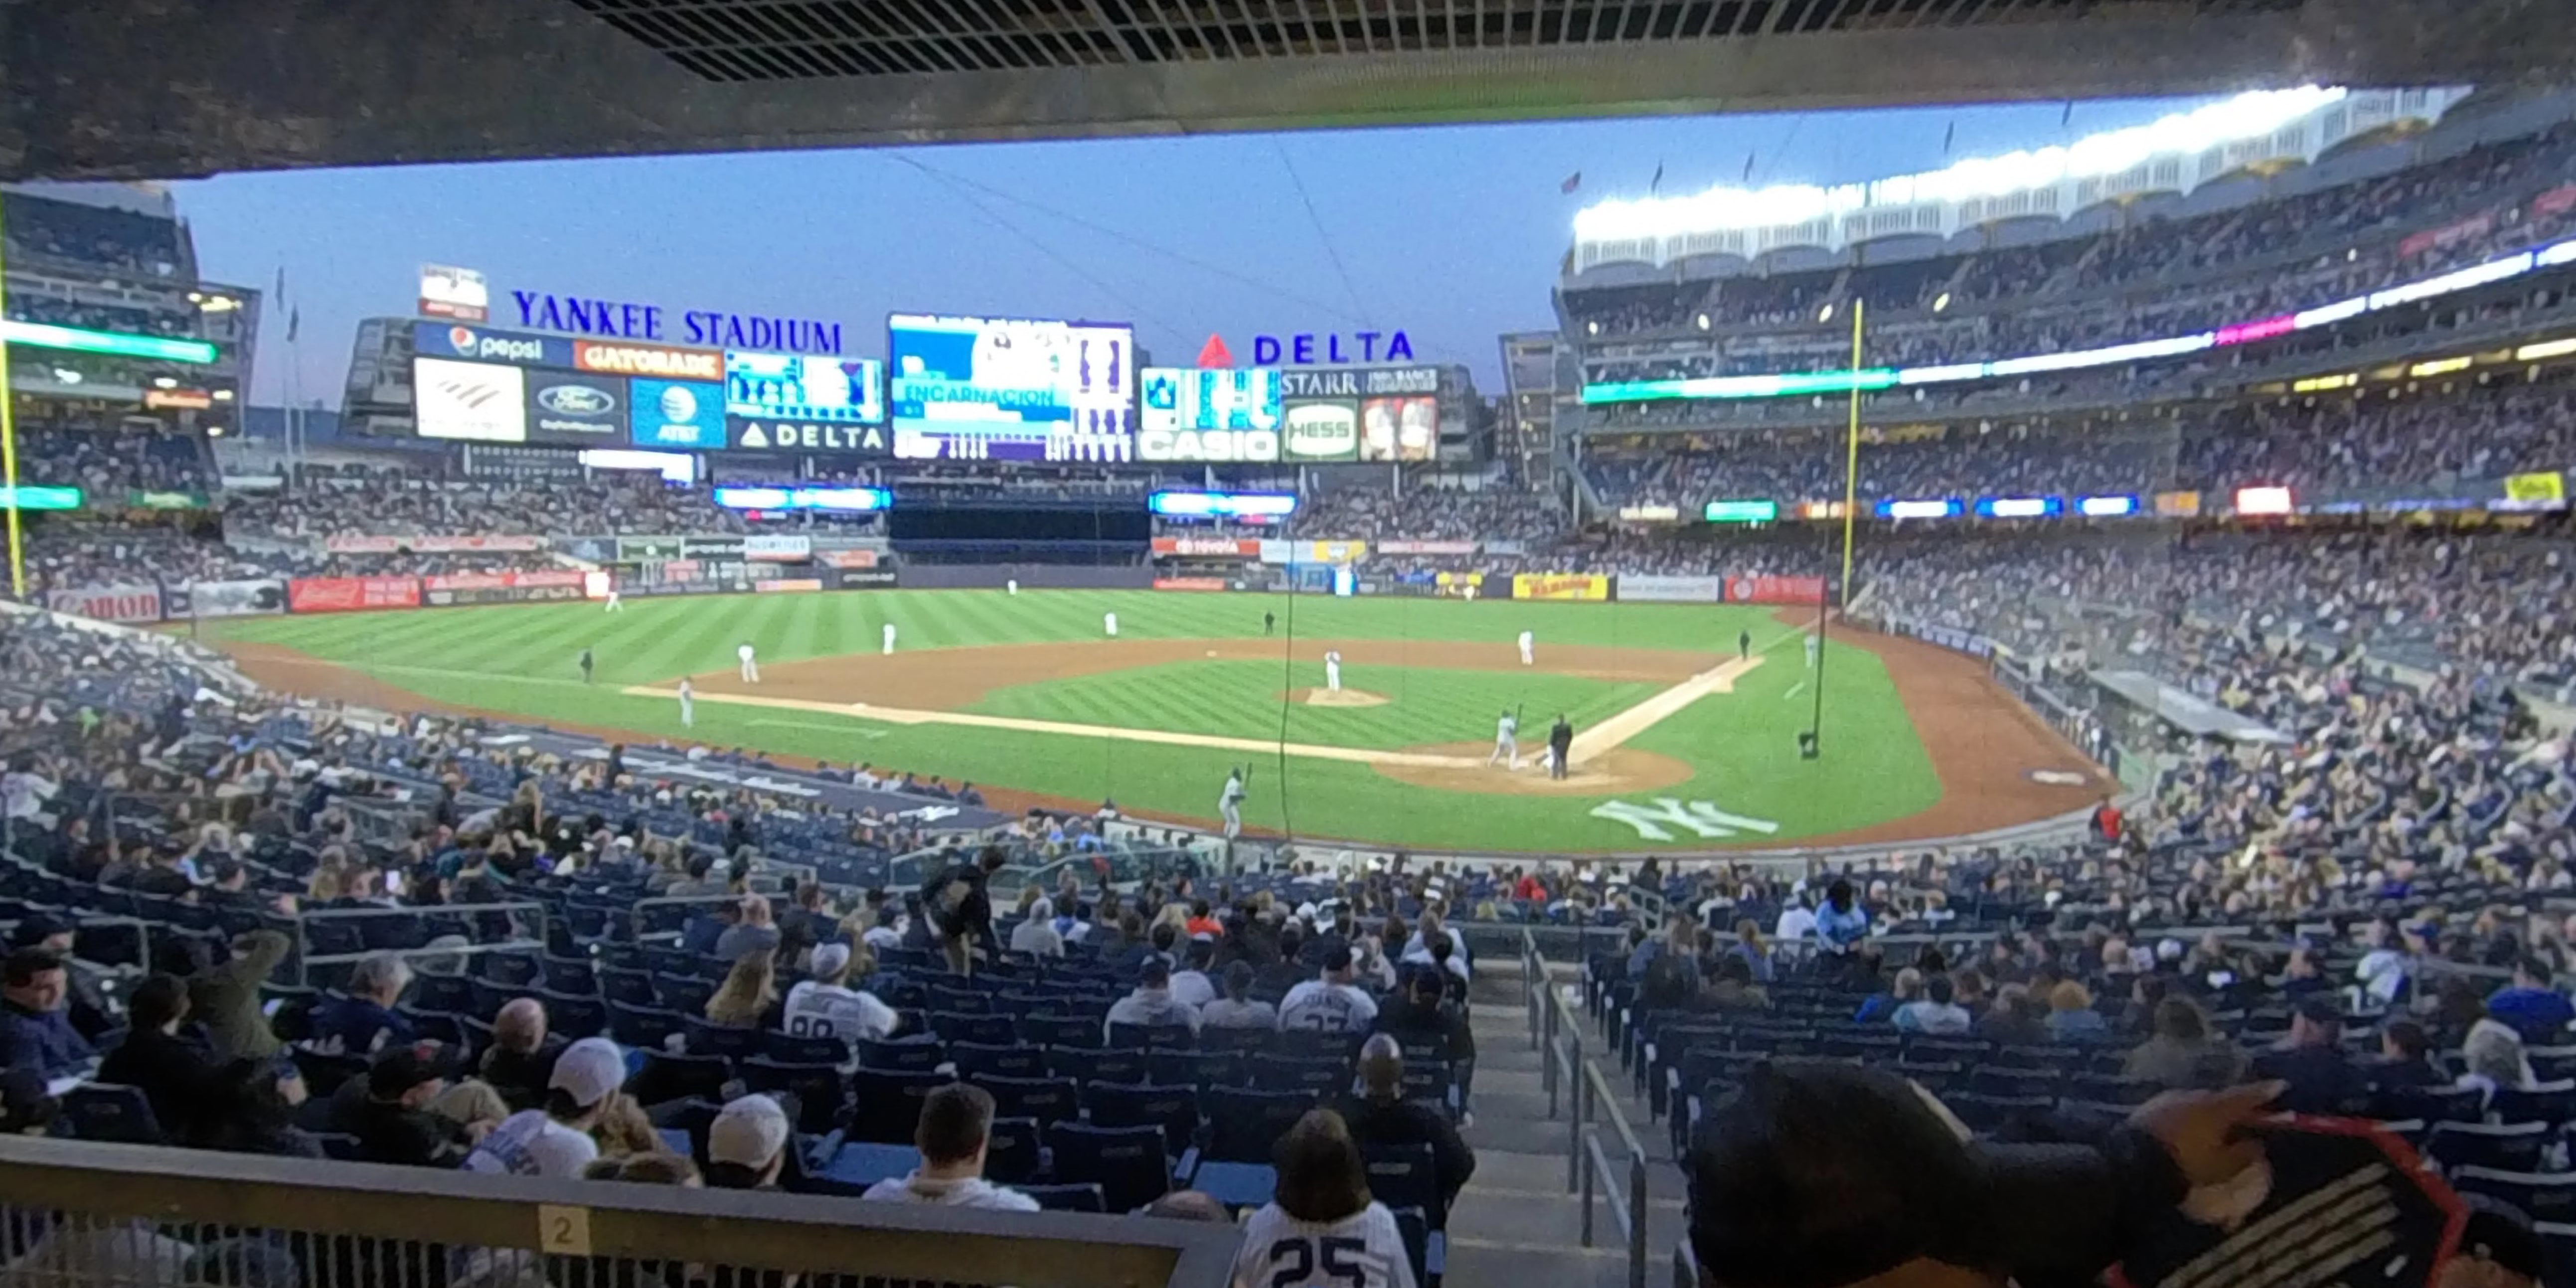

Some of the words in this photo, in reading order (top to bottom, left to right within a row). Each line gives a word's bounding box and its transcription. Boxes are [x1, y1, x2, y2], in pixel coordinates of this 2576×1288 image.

[510, 290, 663, 341] YANKEE
[683, 310, 841, 354] STADIUM
[480, 337, 542, 360] pepsi
[584, 346, 717, 377] GATORADE
[1254, 329, 1414, 365] DELTA
[903, 385, 1054, 406] ENCARNACION
[1282, 372, 1358, 395] STARR
[777, 424, 883, 448] DELTA
[1288, 422, 1350, 438] HESS
[1140, 430, 1278, 461] CASIO
[553, 1216, 574, 1245] 2
[1270, 1236, 1365, 1288] 25
